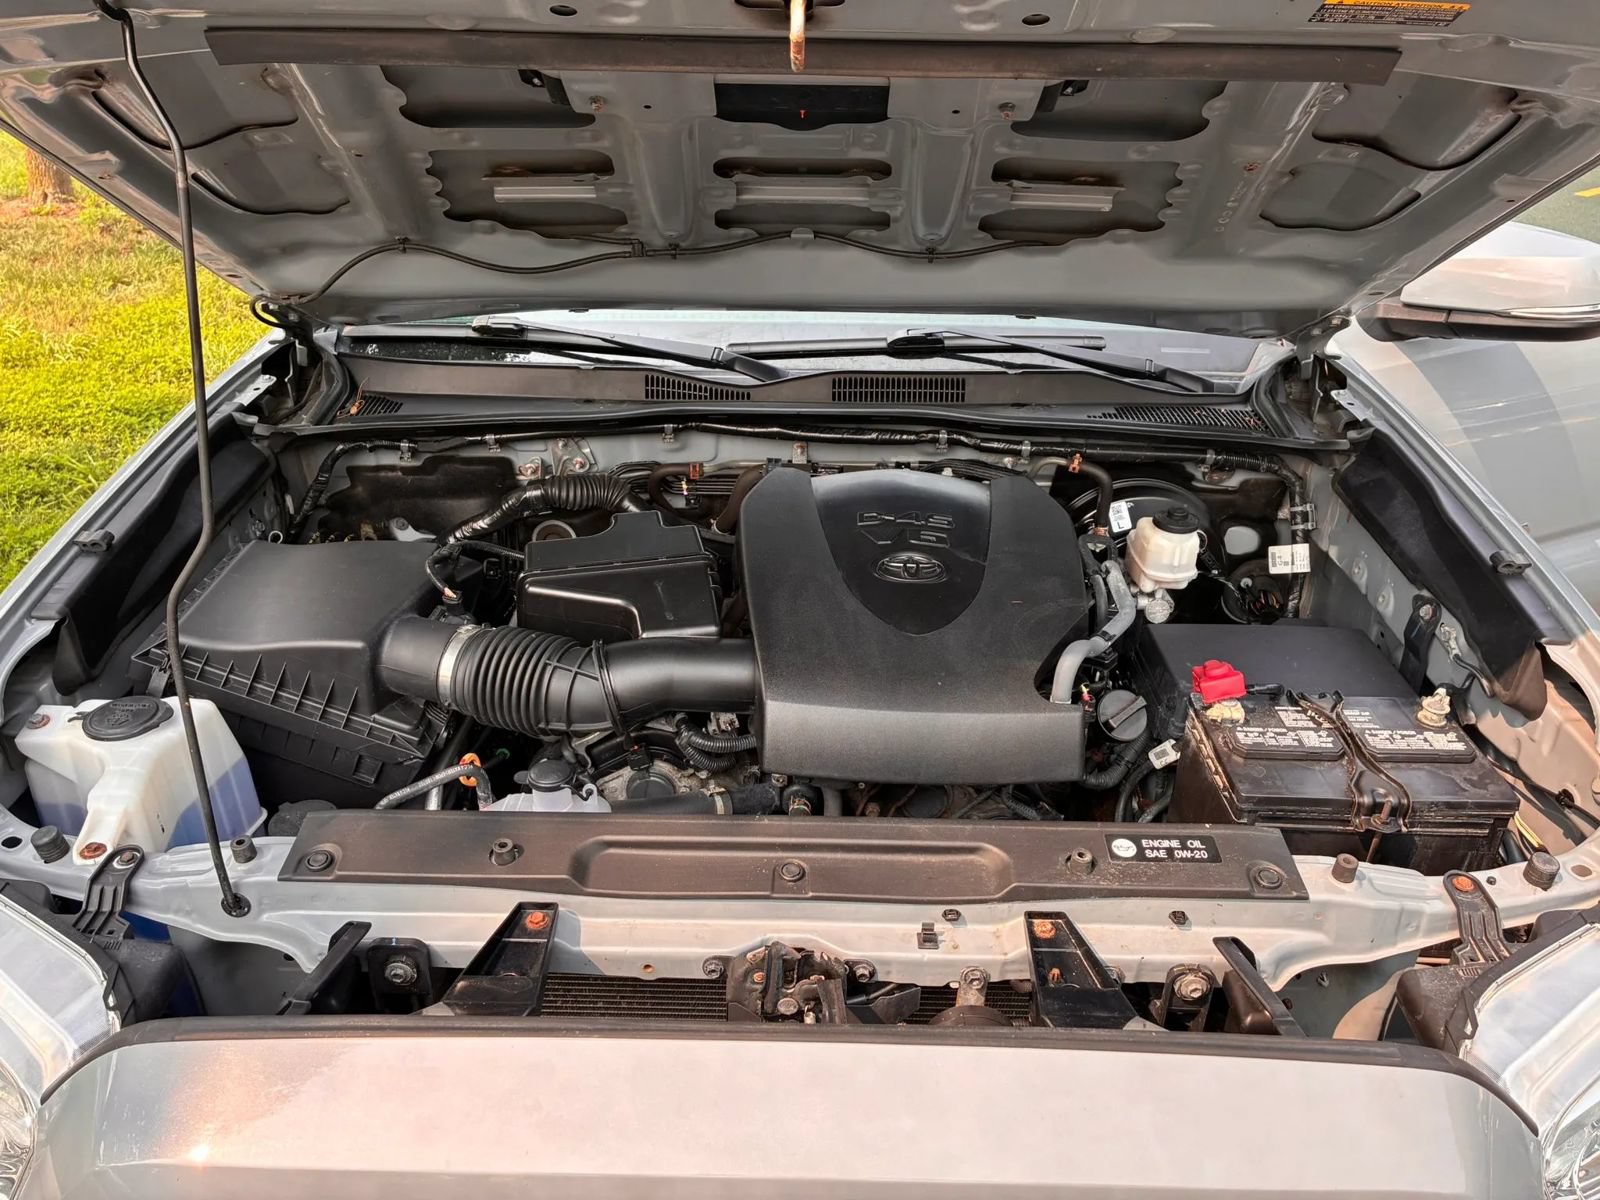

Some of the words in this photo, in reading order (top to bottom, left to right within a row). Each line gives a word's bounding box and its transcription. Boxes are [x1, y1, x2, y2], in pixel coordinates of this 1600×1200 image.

[860, 528, 950, 547] V6
[1141, 839, 1182, 848] ENGINE
[1187, 840, 1206, 849] OIL
[1144, 849, 1168, 858] SAE
[1174, 849, 1208, 859] 0W-20
